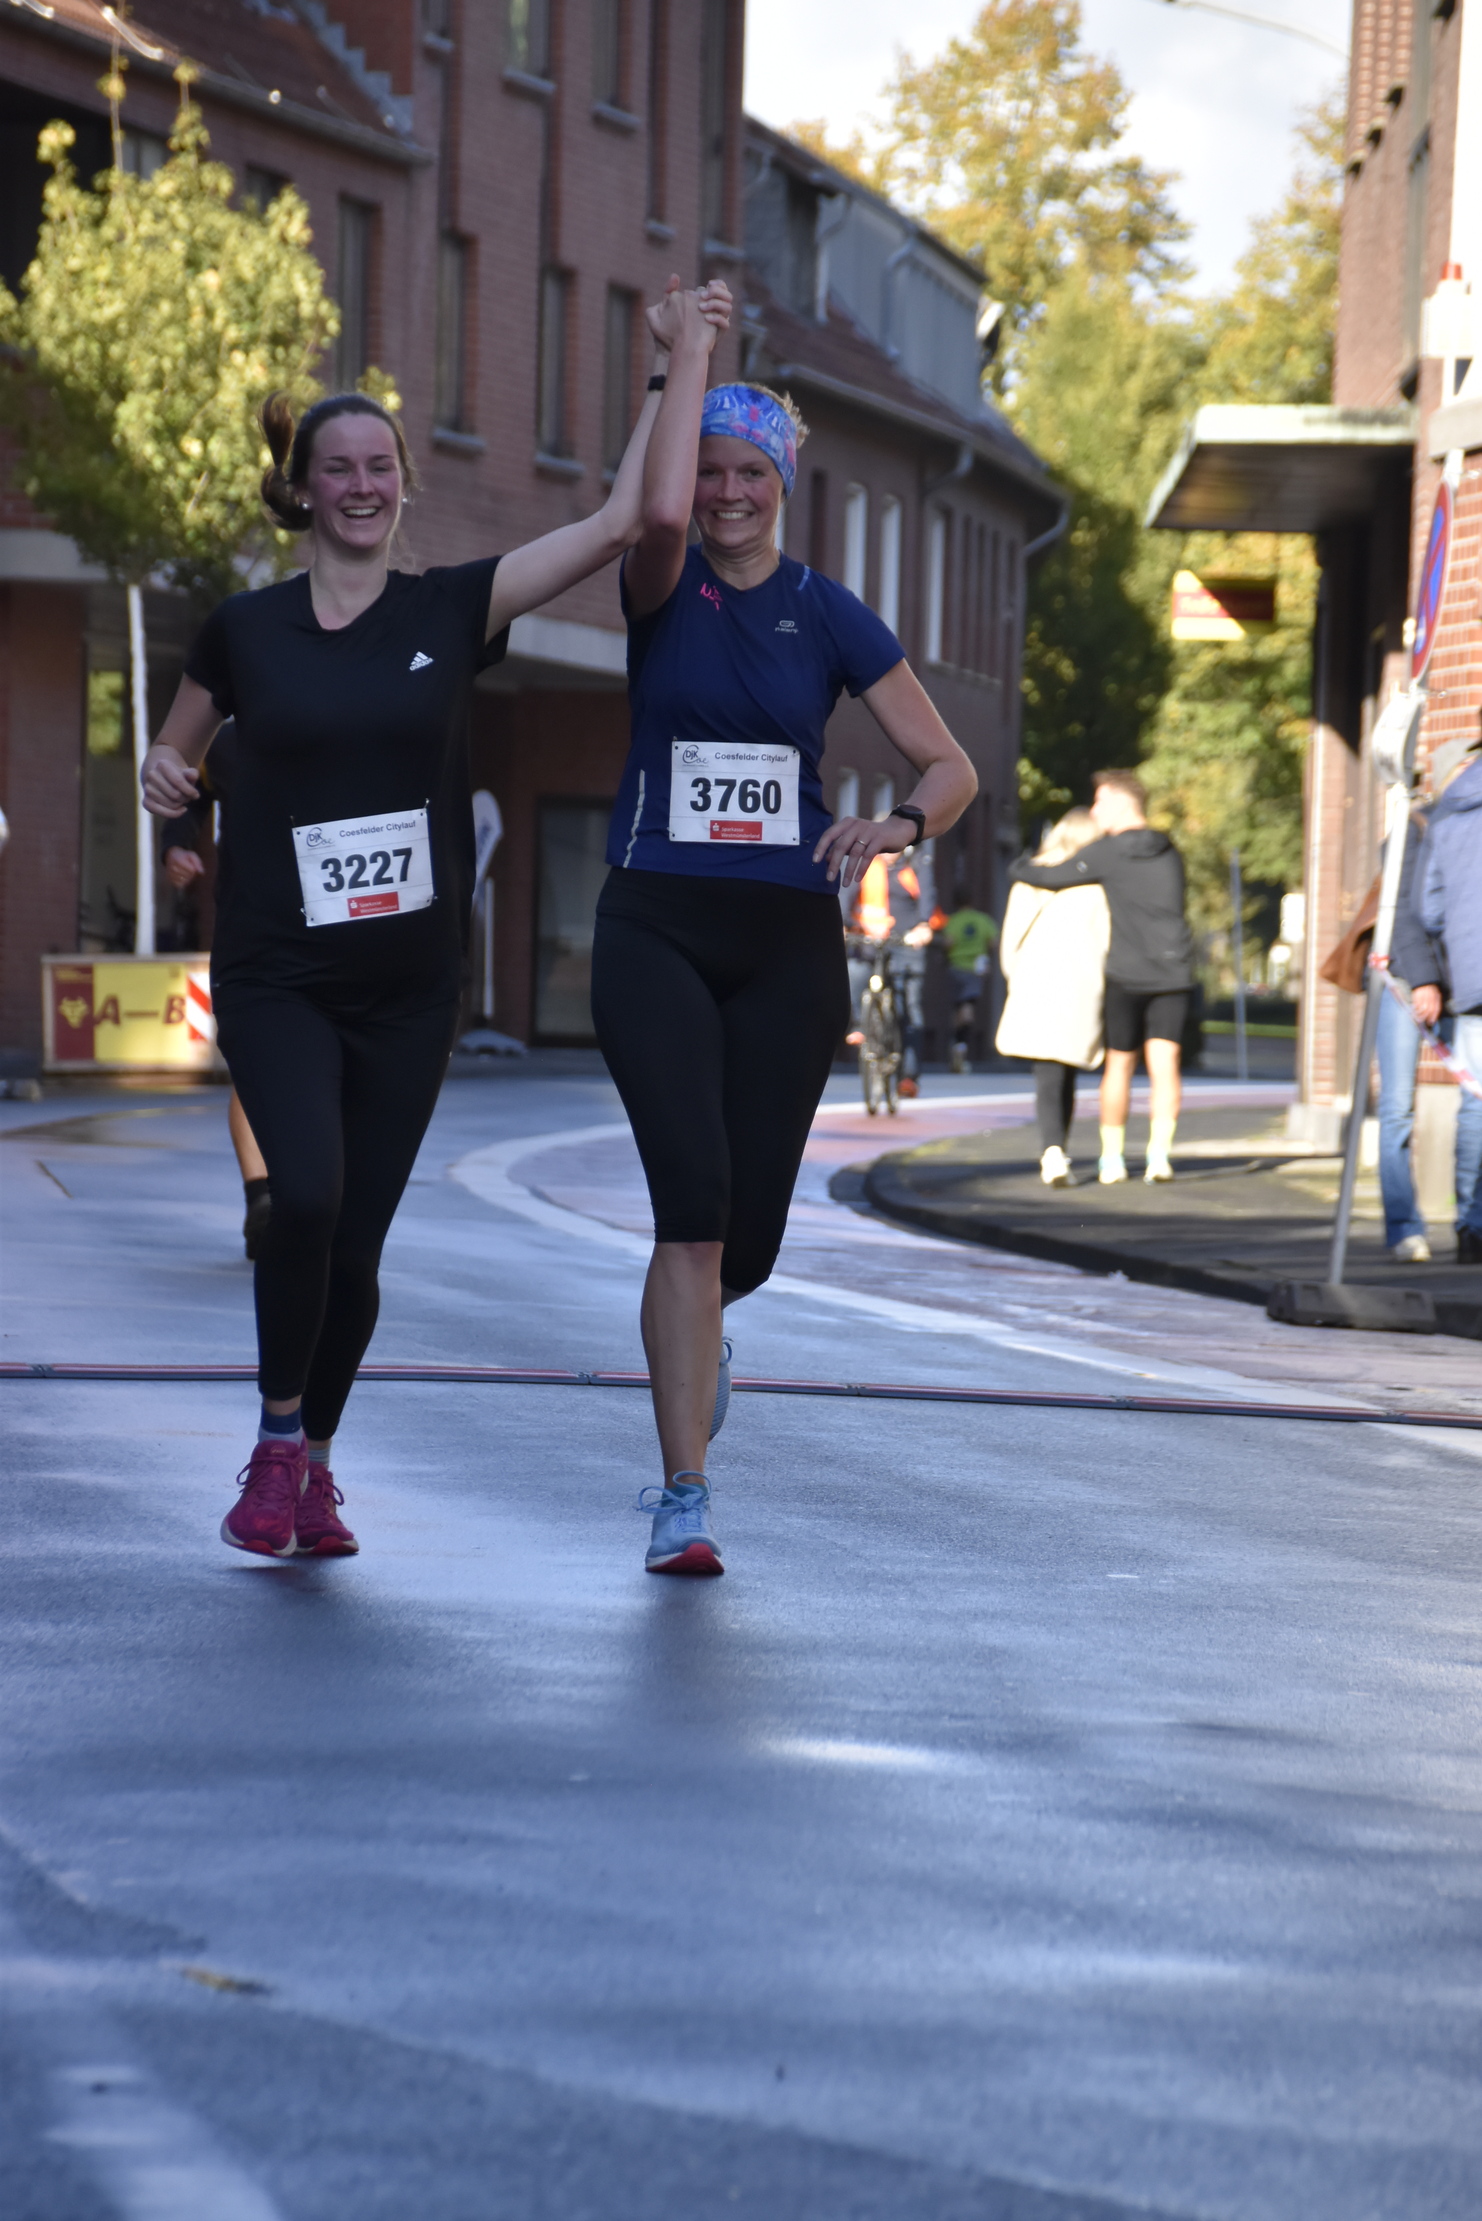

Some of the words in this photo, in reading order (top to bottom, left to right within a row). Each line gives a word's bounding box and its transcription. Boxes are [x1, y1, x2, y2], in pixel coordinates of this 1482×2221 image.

[714, 752, 759, 761] Coesfelder
[760, 753, 788, 763] Citylauf
[690, 777, 782, 814] 3760
[339, 824, 384, 838] Coesfelder
[385, 820, 416, 832] Citylauf
[321, 847, 413, 893] 3227
